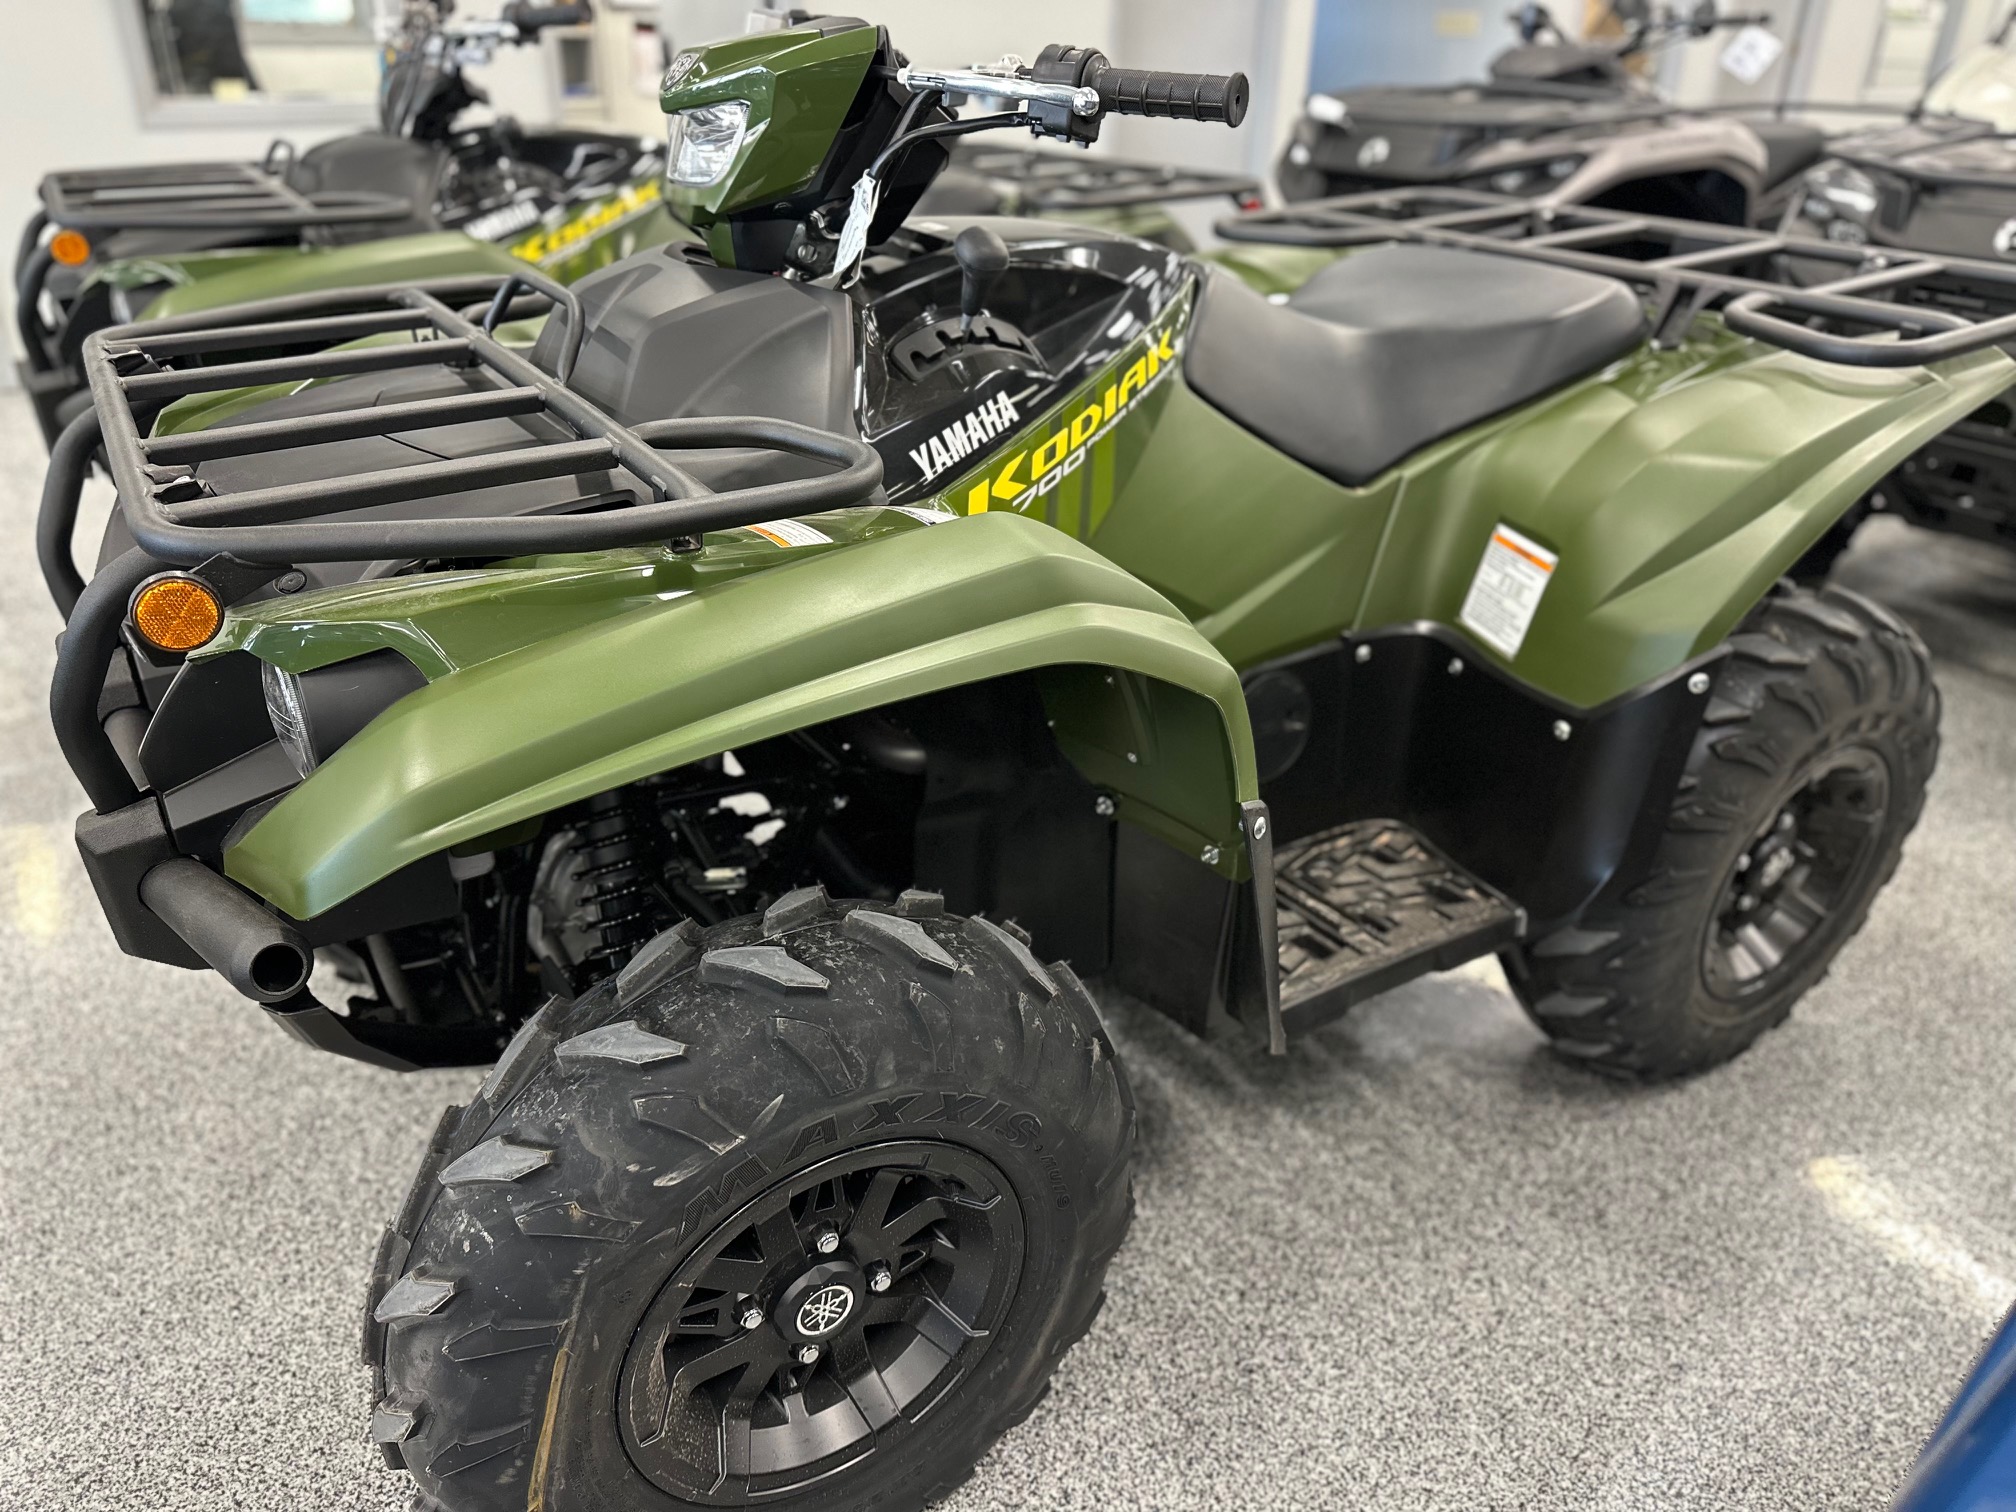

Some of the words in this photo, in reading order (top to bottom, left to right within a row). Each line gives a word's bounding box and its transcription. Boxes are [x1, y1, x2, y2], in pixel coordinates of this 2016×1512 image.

[909, 390, 1020, 482] YAMAHA
[968, 327, 1174, 516] KODIAK
[1012, 449, 1085, 513] 700
[676, 1092, 1042, 1247] MAXXIS
